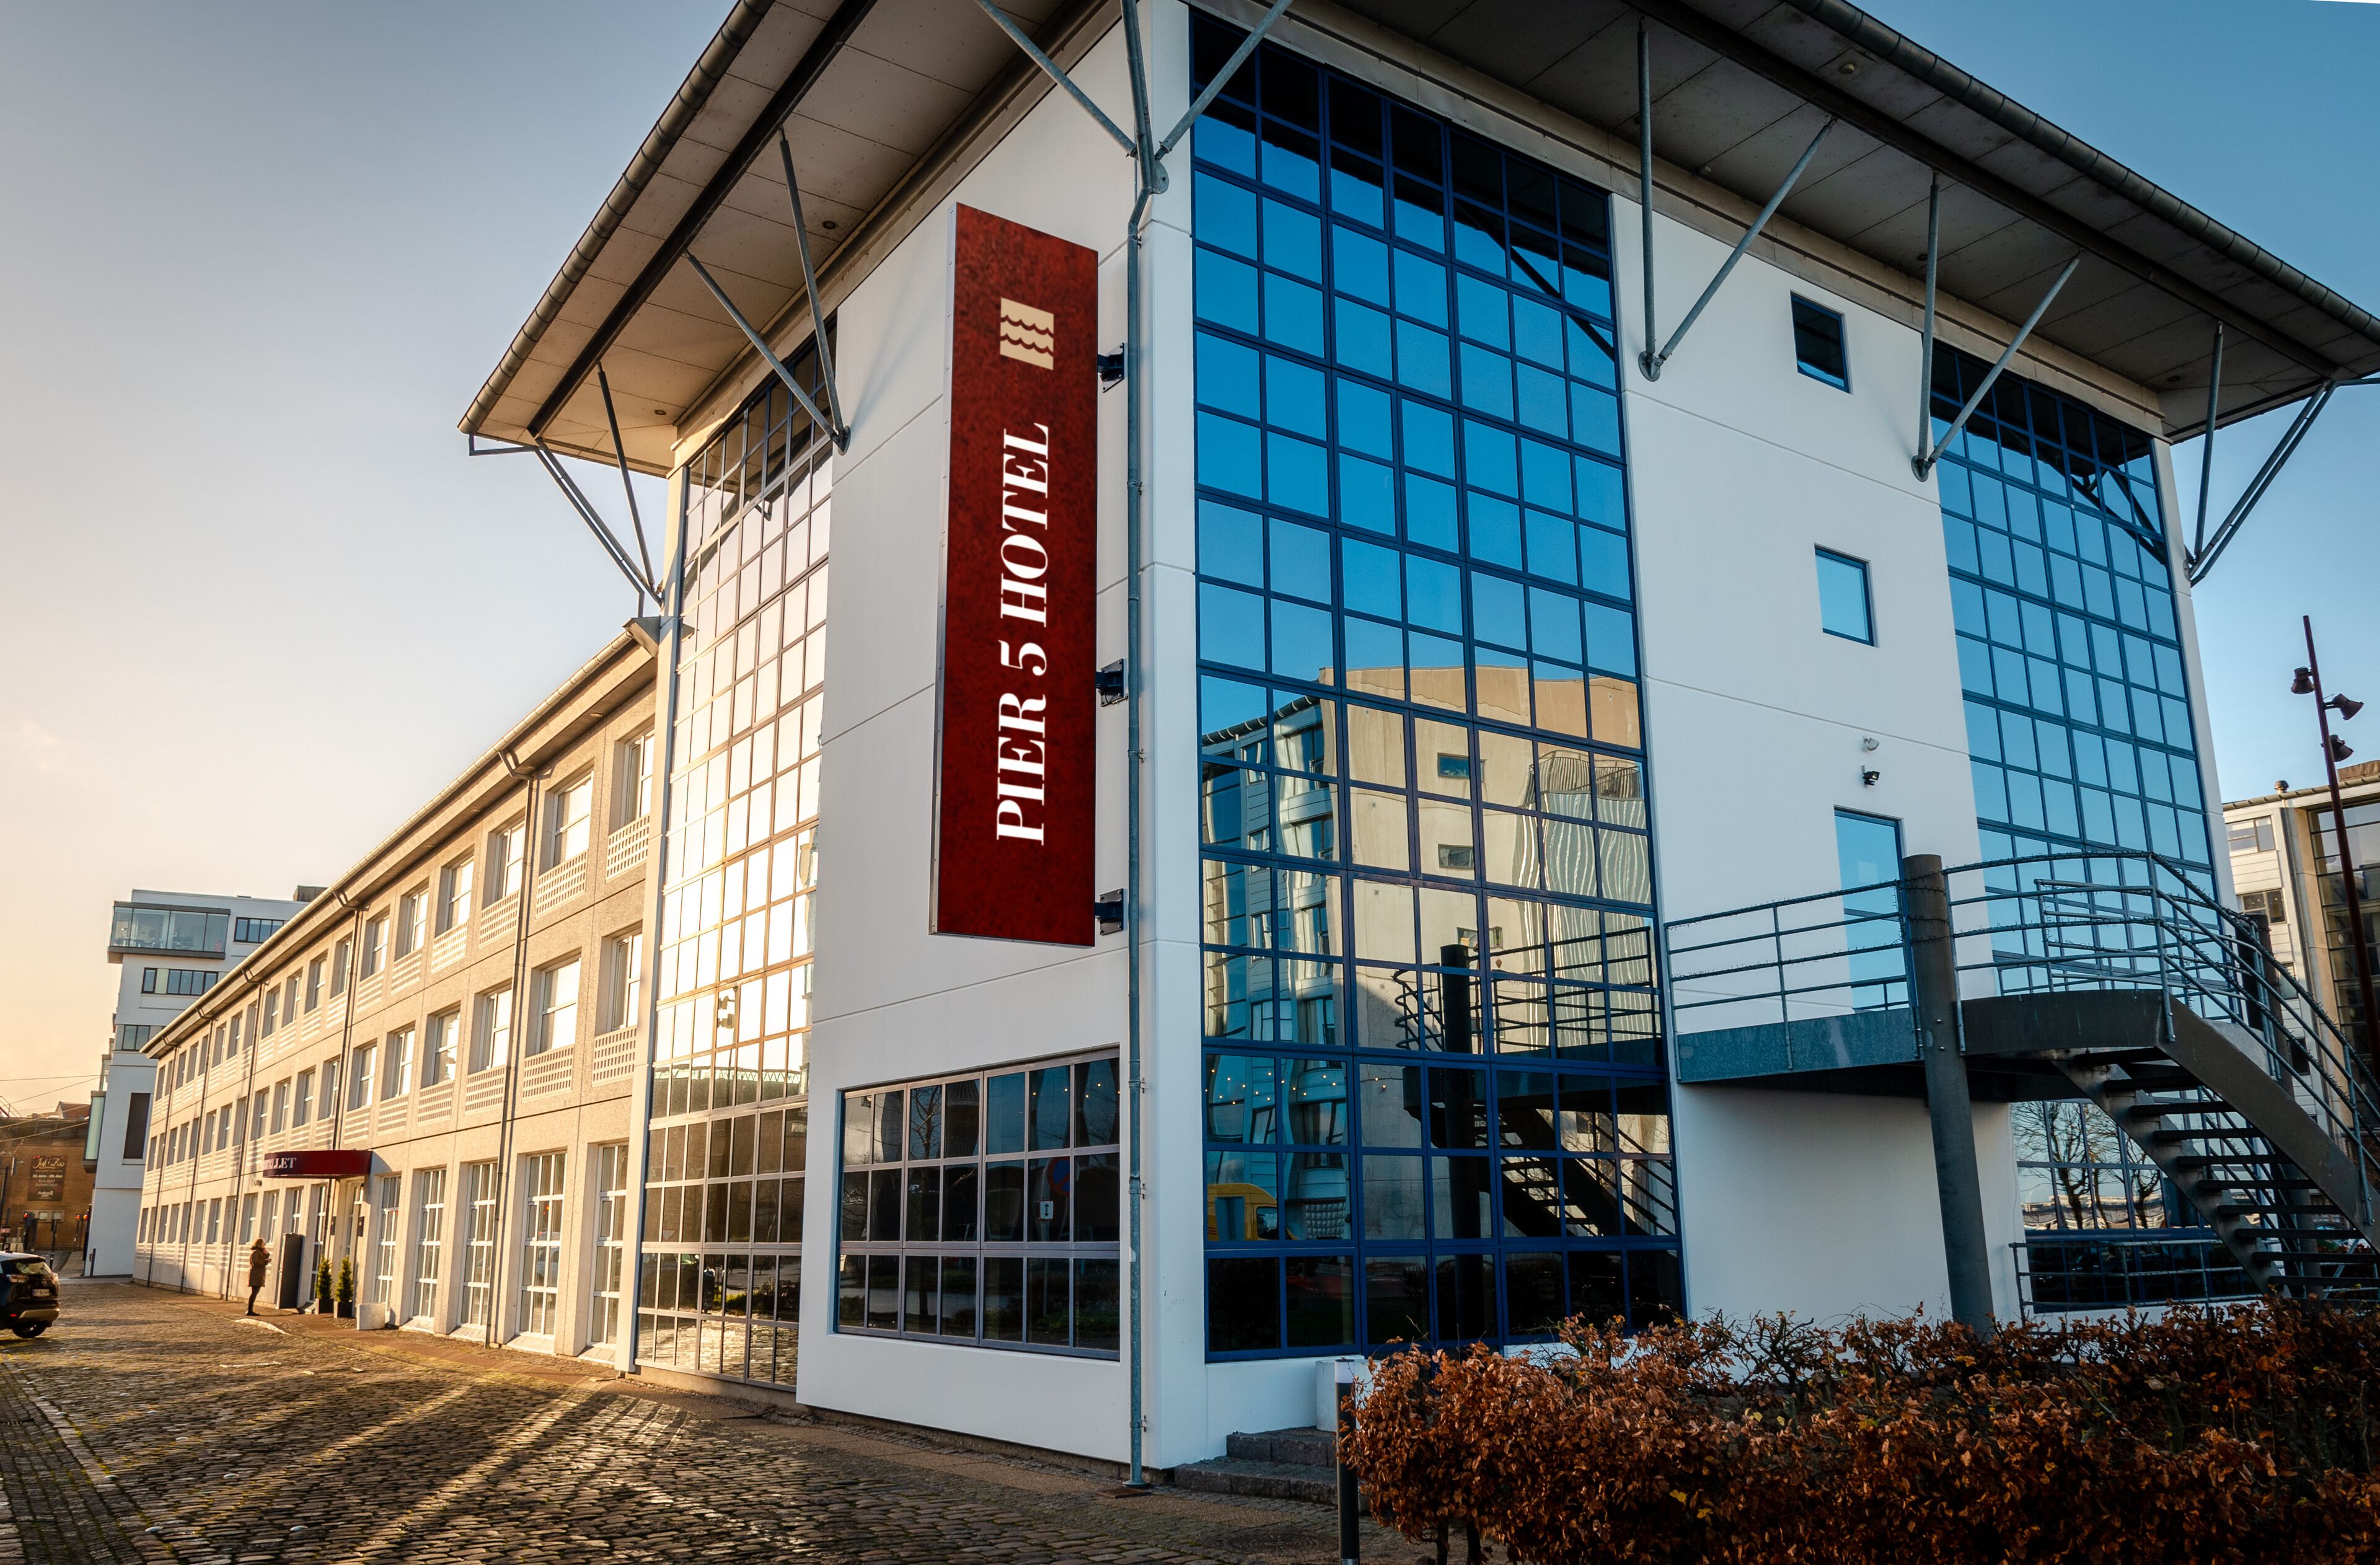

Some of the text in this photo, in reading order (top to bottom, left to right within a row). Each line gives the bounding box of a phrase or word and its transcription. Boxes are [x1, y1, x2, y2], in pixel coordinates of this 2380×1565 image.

[996, 423, 1049, 846] PIER 5 HOTEL
